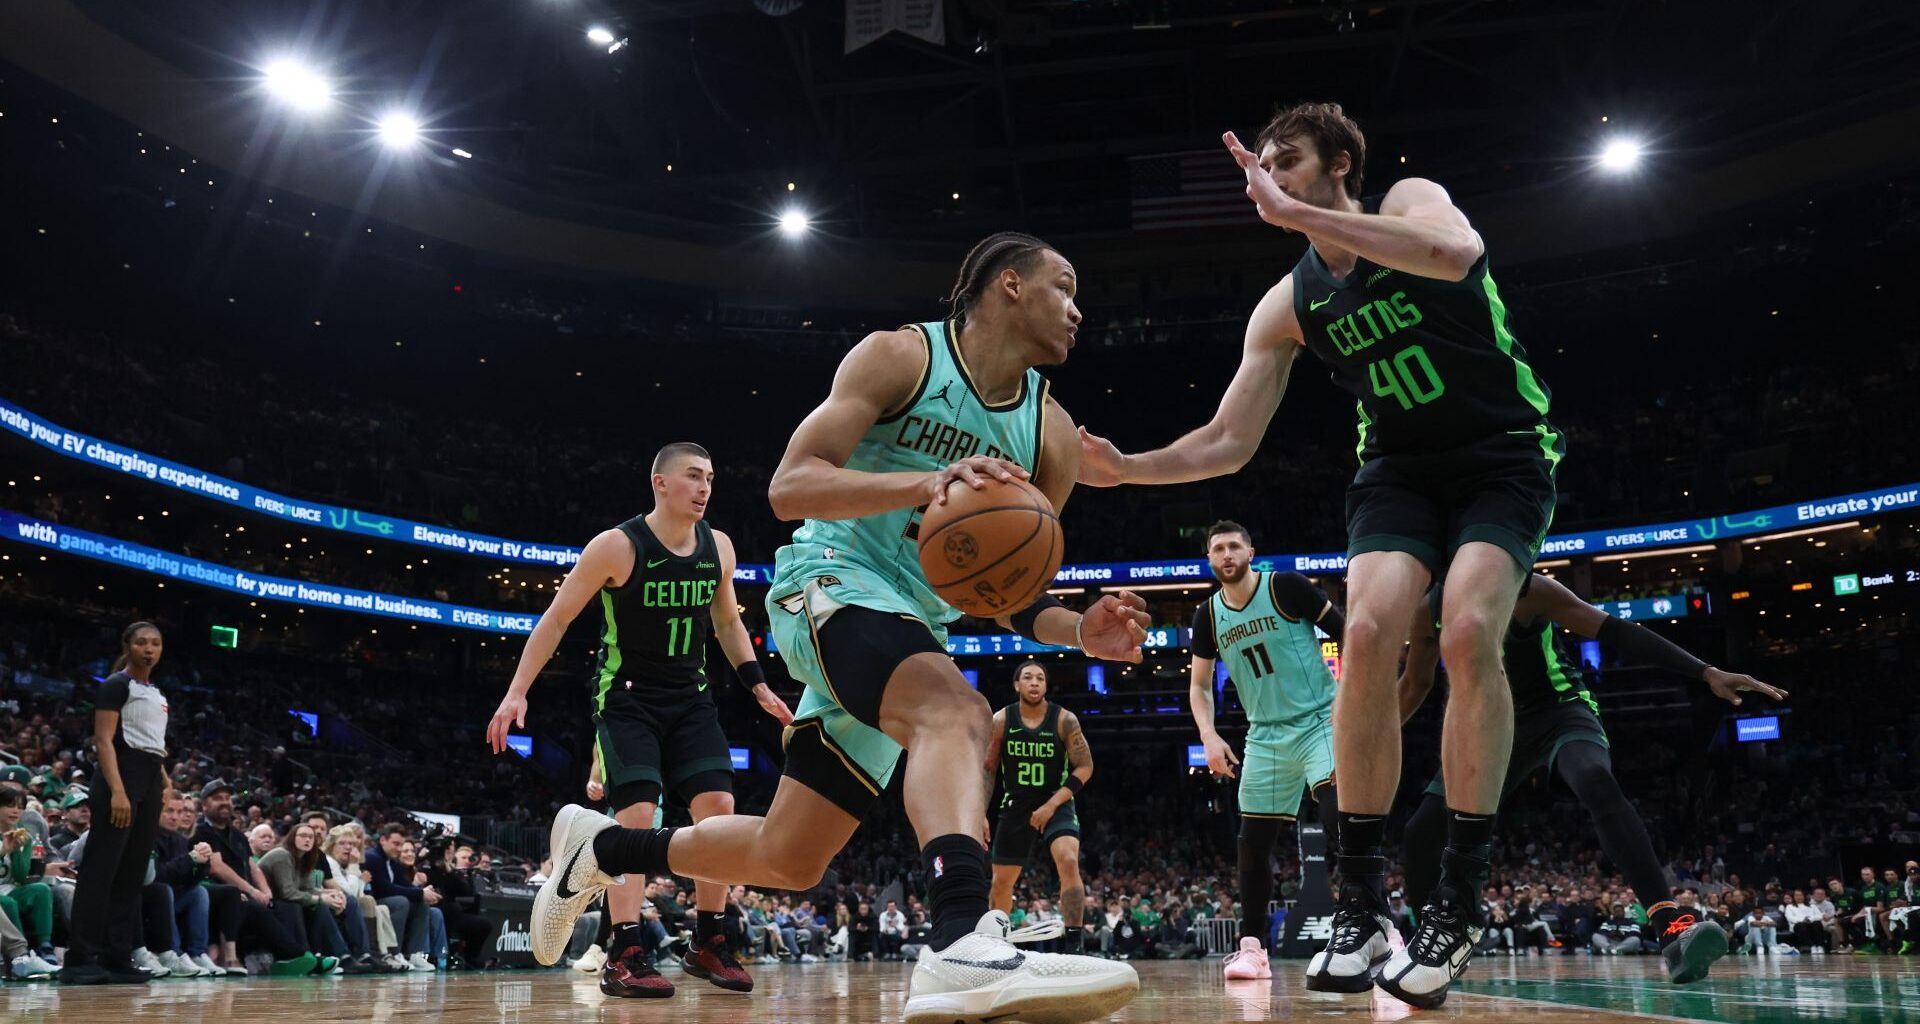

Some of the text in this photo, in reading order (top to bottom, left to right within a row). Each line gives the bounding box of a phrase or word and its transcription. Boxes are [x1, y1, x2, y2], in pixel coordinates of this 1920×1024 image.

[1369, 345, 1445, 411] 40
[31, 421, 62, 446] your
[63, 433, 86, 453] EV
[87, 443, 157, 479] charging
[159, 465, 240, 500] experience
[254, 495, 322, 522] EVERSOURCE
[1797, 490, 1918, 521] Elevate your
[414, 526, 580, 565] Elevate your EV chargin
[1606, 528, 1688, 547] EVERSOURCE
[18, 522, 442, 619] with game-changing rebates for your home and business.
[1055, 566, 1112, 581] erience
[1130, 565, 1200, 578] EVERSOURCE
[1836, 573, 1894, 591] TD Bank
[643, 580, 717, 607] CELTICS
[453, 610, 533, 631] EVERSOURCE
[1219, 616, 1279, 650] CHARLOTTE
[666, 617, 693, 657] 11
[1242, 642, 1275, 680] 11
[1007, 741, 1055, 757] CELTICS
[1018, 762, 1045, 786] 20
